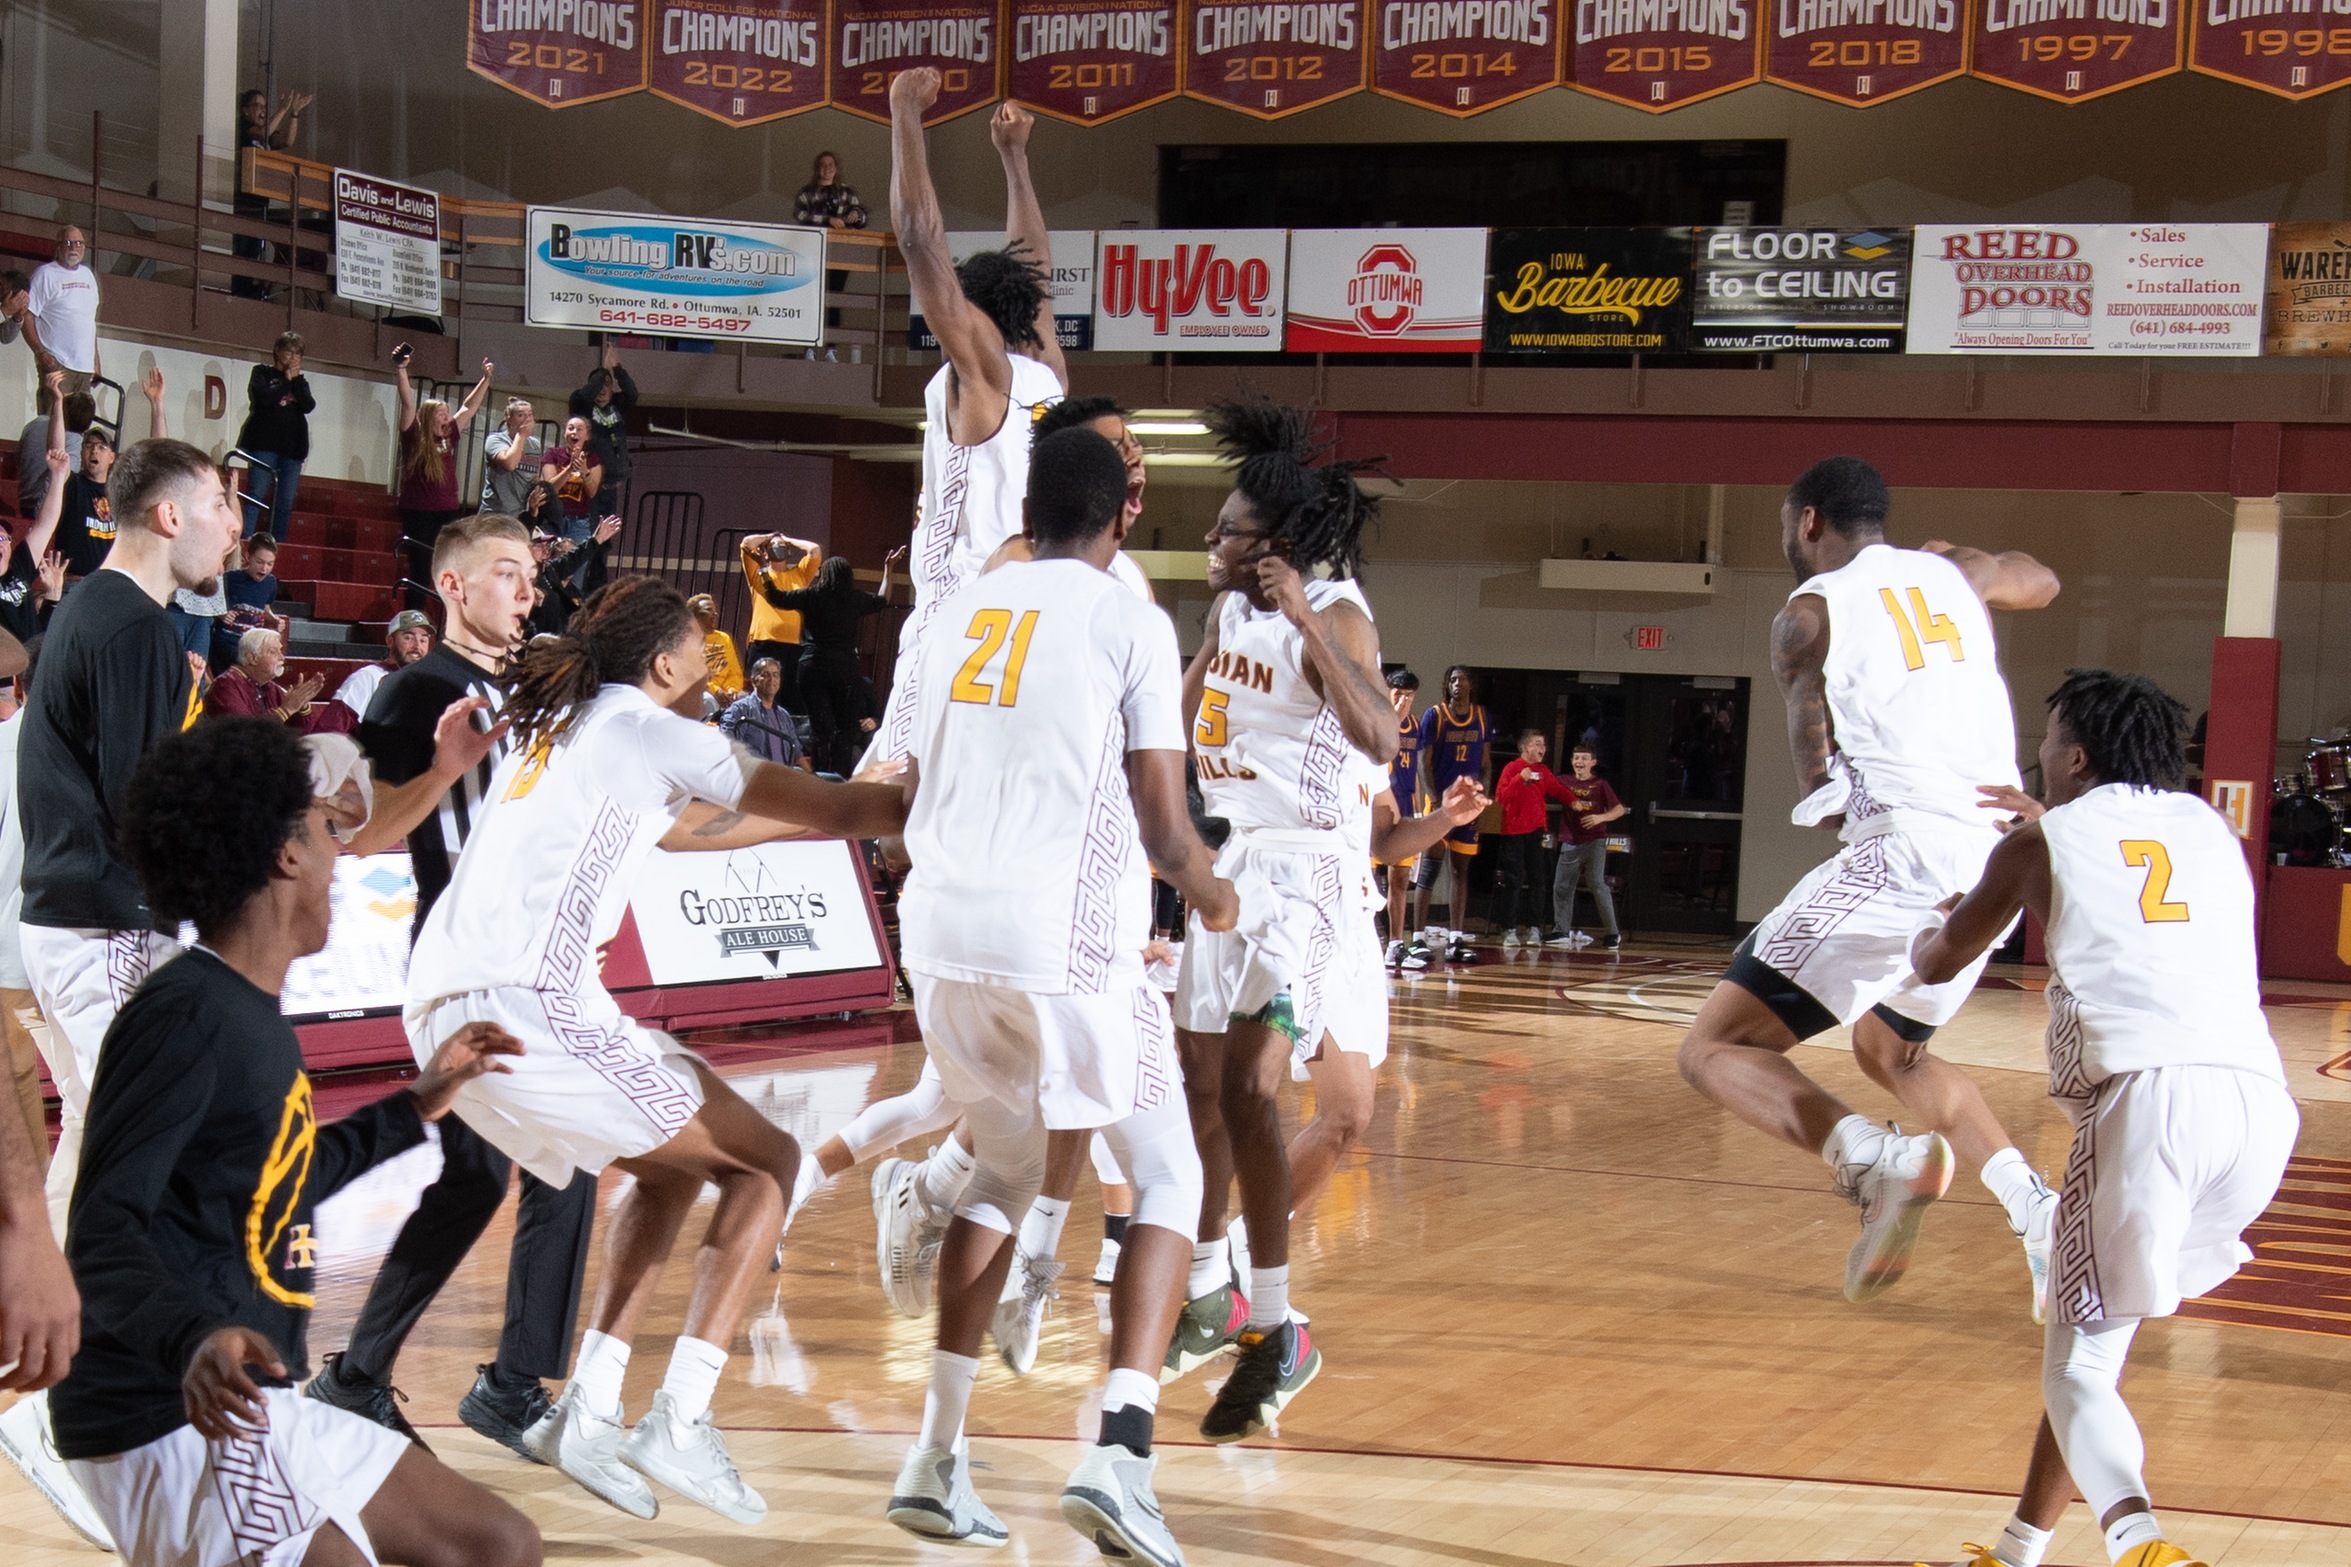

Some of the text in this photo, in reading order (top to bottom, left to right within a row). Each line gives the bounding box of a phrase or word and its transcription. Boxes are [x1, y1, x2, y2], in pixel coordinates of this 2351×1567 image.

[706, 3, 757, 16] COLLEGE
[758, 9, 817, 20] NATIONAL
[882, 9, 927, 19] DIVISION
[935, 8, 991, 18] NATIONAL
[1057, 2, 1101, 12] DIVISION
[1110, 0, 1169, 10] NATIONAL
[482, 0, 635, 50] CHAMPIONS
[1196, 2, 1356, 56] CHAMPIONS
[1383, 0, 1549, 51] CHAMPIONS
[1576, 0, 1746, 45] CHAMPIONS
[663, 8, 816, 68] CHAMPIONS
[842, 17, 990, 69] CHAMPIONS
[1016, 10, 1169, 64] CHAMPIONS
[2017, 34, 2133, 62] 1997
[2240, 28, 2351, 57] 1998
[507, 42, 603, 75] 2021
[1410, 52, 1518, 79] 2014
[1604, 45, 1713, 73] 2015
[1808, 39, 1922, 68] 2018
[684, 61, 793, 93] 2022
[861, 68, 969, 95] 20
[1049, 63, 1135, 90] 2011
[1223, 55, 1323, 82] 2012
[339, 177, 435, 219] Davis and Lewis
[341, 204, 433, 236] Certified Public Accountants
[1708, 232, 1836, 260] FLOOR
[1939, 229, 2080, 261] REED
[2140, 227, 2186, 243] Sales
[550, 223, 797, 277] Bowling RV's.com
[1550, 253, 1585, 270] IOWA
[2138, 253, 2204, 268] Service
[584, 266, 765, 287] Your source for adventures on the road
[1706, 271, 1897, 299] to CEILING
[1955, 262, 2094, 283] OVERHEAD
[2136, 279, 2241, 294] Installation
[1347, 273, 1424, 308] OTTUMWA
[1496, 261, 1681, 314] Barbecue
[549, 291, 801, 319] 14270 Sycamore Rd. Ottumwa, IA. 52501
[1958, 286, 2093, 318] DOORS
[2106, 303, 2258, 317] REEDOVERHEADDOORS.COM
[600, 310, 752, 332] 641-682-5497
[1180, 325, 1270, 337] EMPLOYEE OWNED
[1588, 314, 1625, 322] STORE
[2129, 319, 2231, 337] (641) 684-4993
[1510, 334, 1662, 347] WWW.IOWABBQSTORE.COM
[1704, 335, 1890, 348] www.FTCOttumwa.com
[1988, 332, 2025, 347] Opening
[2026, 333, 2052, 346] Doors
[2053, 333, 2069, 346] For
[2108, 341, 2251, 351] Call Today for your FREE ESTIMATE!!!
[204, 374, 227, 420] D
[1637, 627, 1664, 648] EXIT
[1878, 587, 1965, 672] 14
[951, 608, 1041, 708] 21
[1196, 686, 1230, 747] 5
[1455, 744, 1467, 762] 12
[2118, 840, 2190, 924] 2
[680, 884, 828, 926] GODFREY'S
[726, 928, 808, 947] ALE HOUSE
